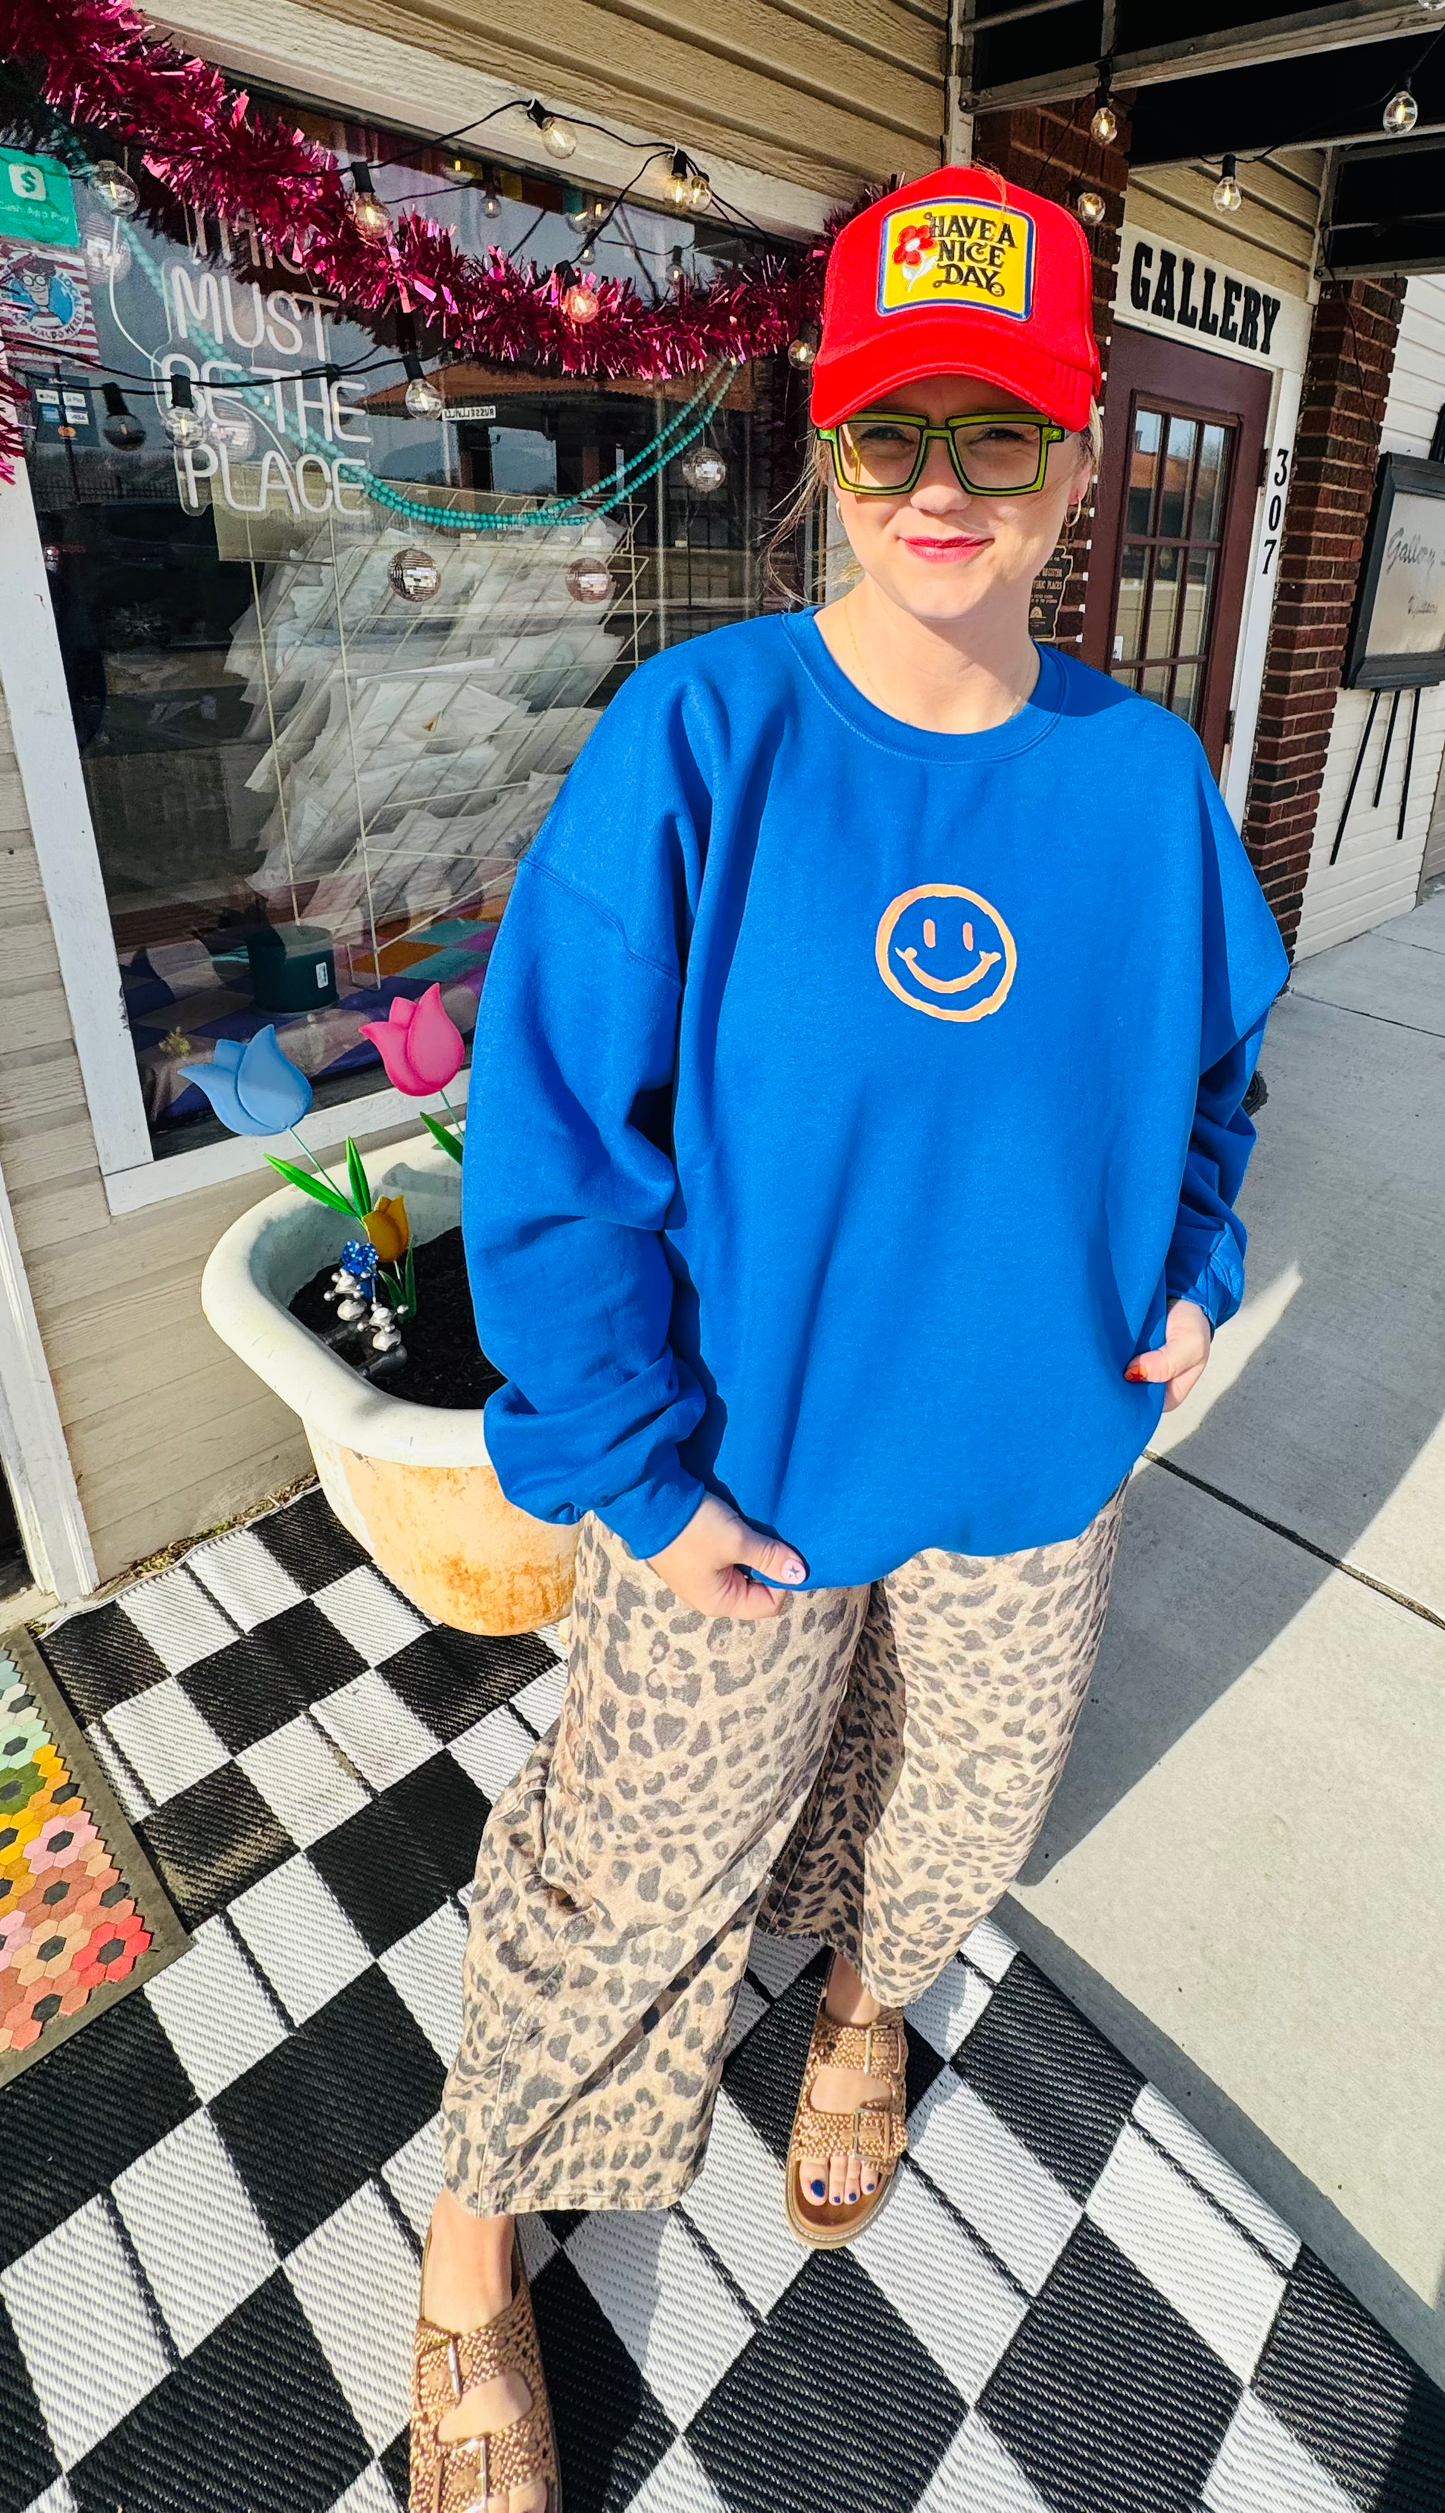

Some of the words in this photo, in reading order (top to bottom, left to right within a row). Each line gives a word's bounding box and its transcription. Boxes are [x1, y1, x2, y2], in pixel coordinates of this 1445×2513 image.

[923, 212, 996, 240] HAVE
[997, 222, 1018, 249] A
[937, 240, 1006, 269] NICE
[171, 265, 339, 361] MUST
[933, 263, 1005, 297] DAY
[1131, 242, 1280, 355] GALLERY
[161, 353, 252, 426] BE
[250, 366, 371, 442] THE
[183, 442, 371, 514] PLACE
